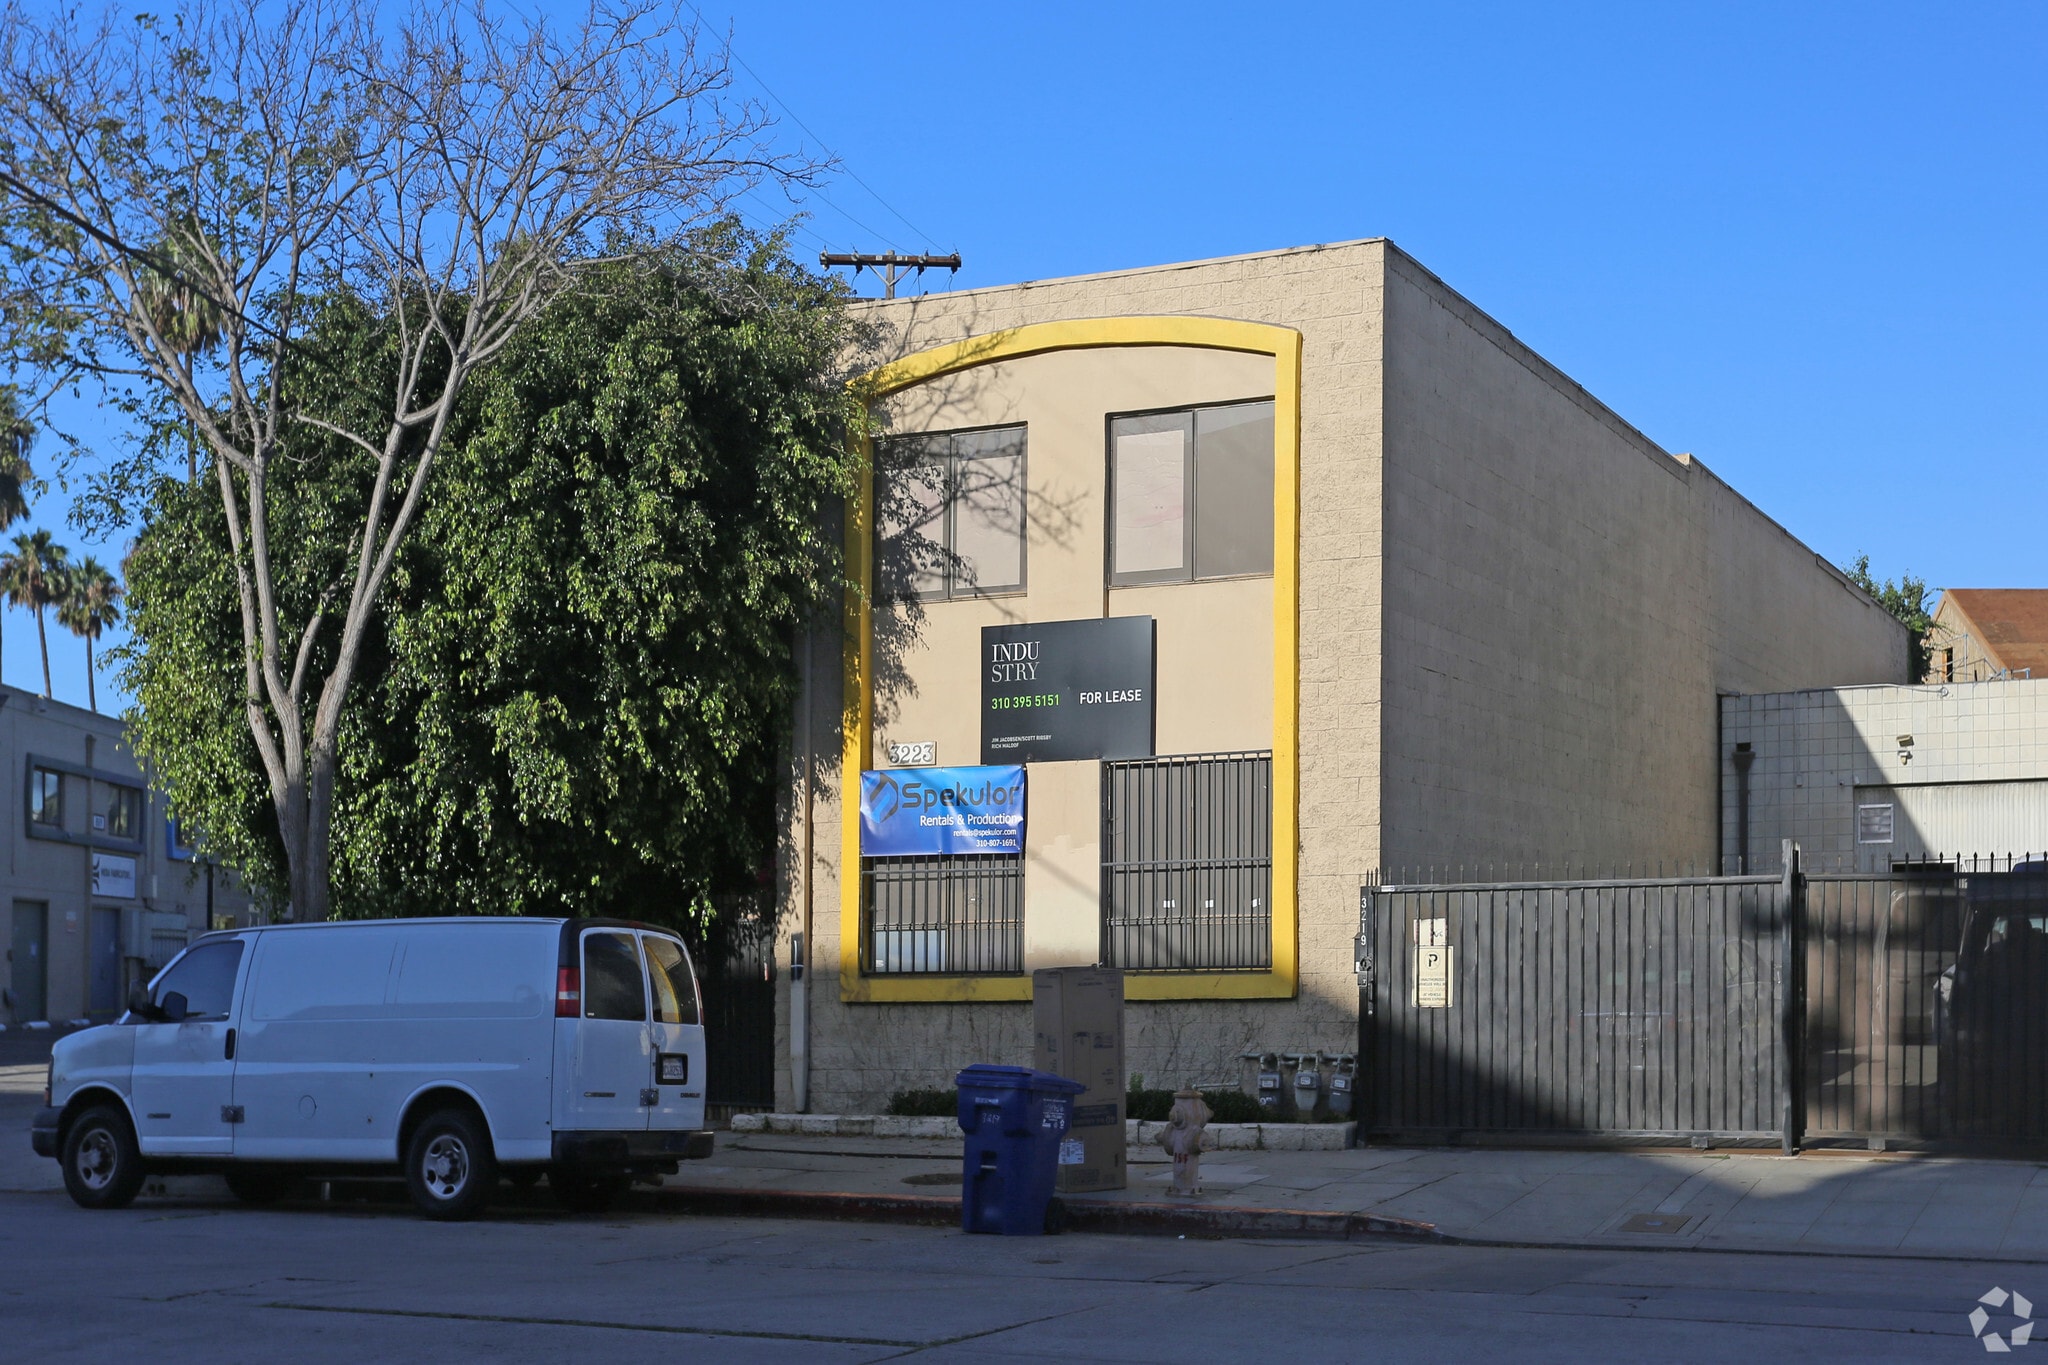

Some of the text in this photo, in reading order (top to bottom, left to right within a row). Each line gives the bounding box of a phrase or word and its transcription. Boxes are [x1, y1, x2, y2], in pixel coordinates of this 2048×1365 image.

[991, 641, 1040, 663] INDU
[991, 661, 1040, 683] STRY
[991, 694, 1059, 710] 310 395 5151
[1079, 689, 1142, 705] FOR LEASE
[889, 744, 934, 764] 3223
[901, 780, 1020, 814] Spekulor
[920, 812, 1017, 827] Rentals & Production
[953, 828, 1017, 837] rentals@spekulor.com
[976, 838, 1016, 848] 310-807-1691
